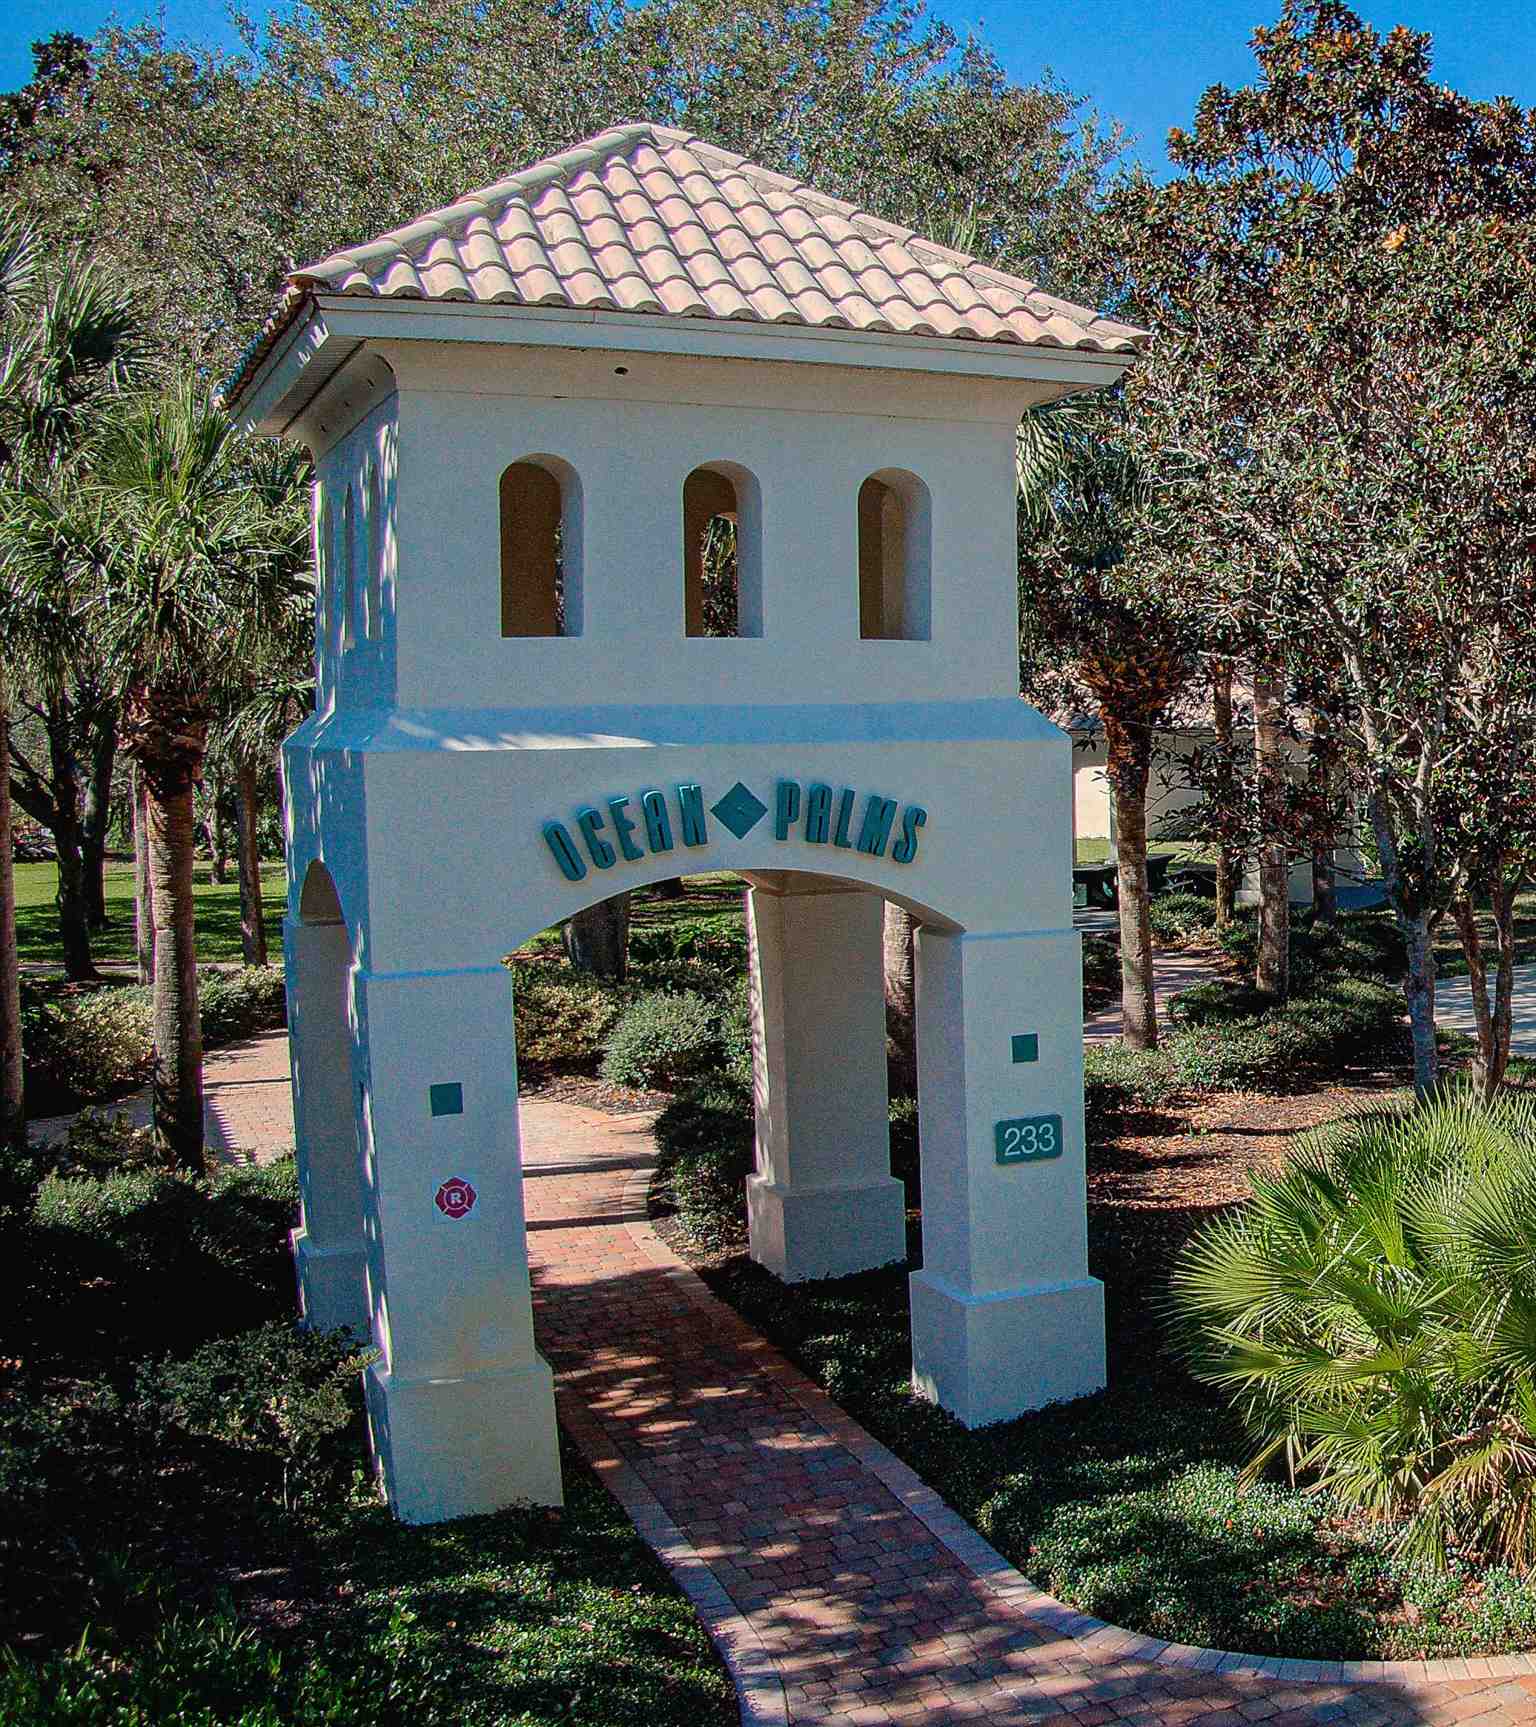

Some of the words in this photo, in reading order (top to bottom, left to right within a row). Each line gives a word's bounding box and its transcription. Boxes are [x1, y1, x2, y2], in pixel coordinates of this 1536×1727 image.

[542, 784, 708, 881] OCEAN
[775, 779, 927, 864] PALMS
[1004, 1123, 1055, 1156] 233
[450, 1192, 462, 1204] R
